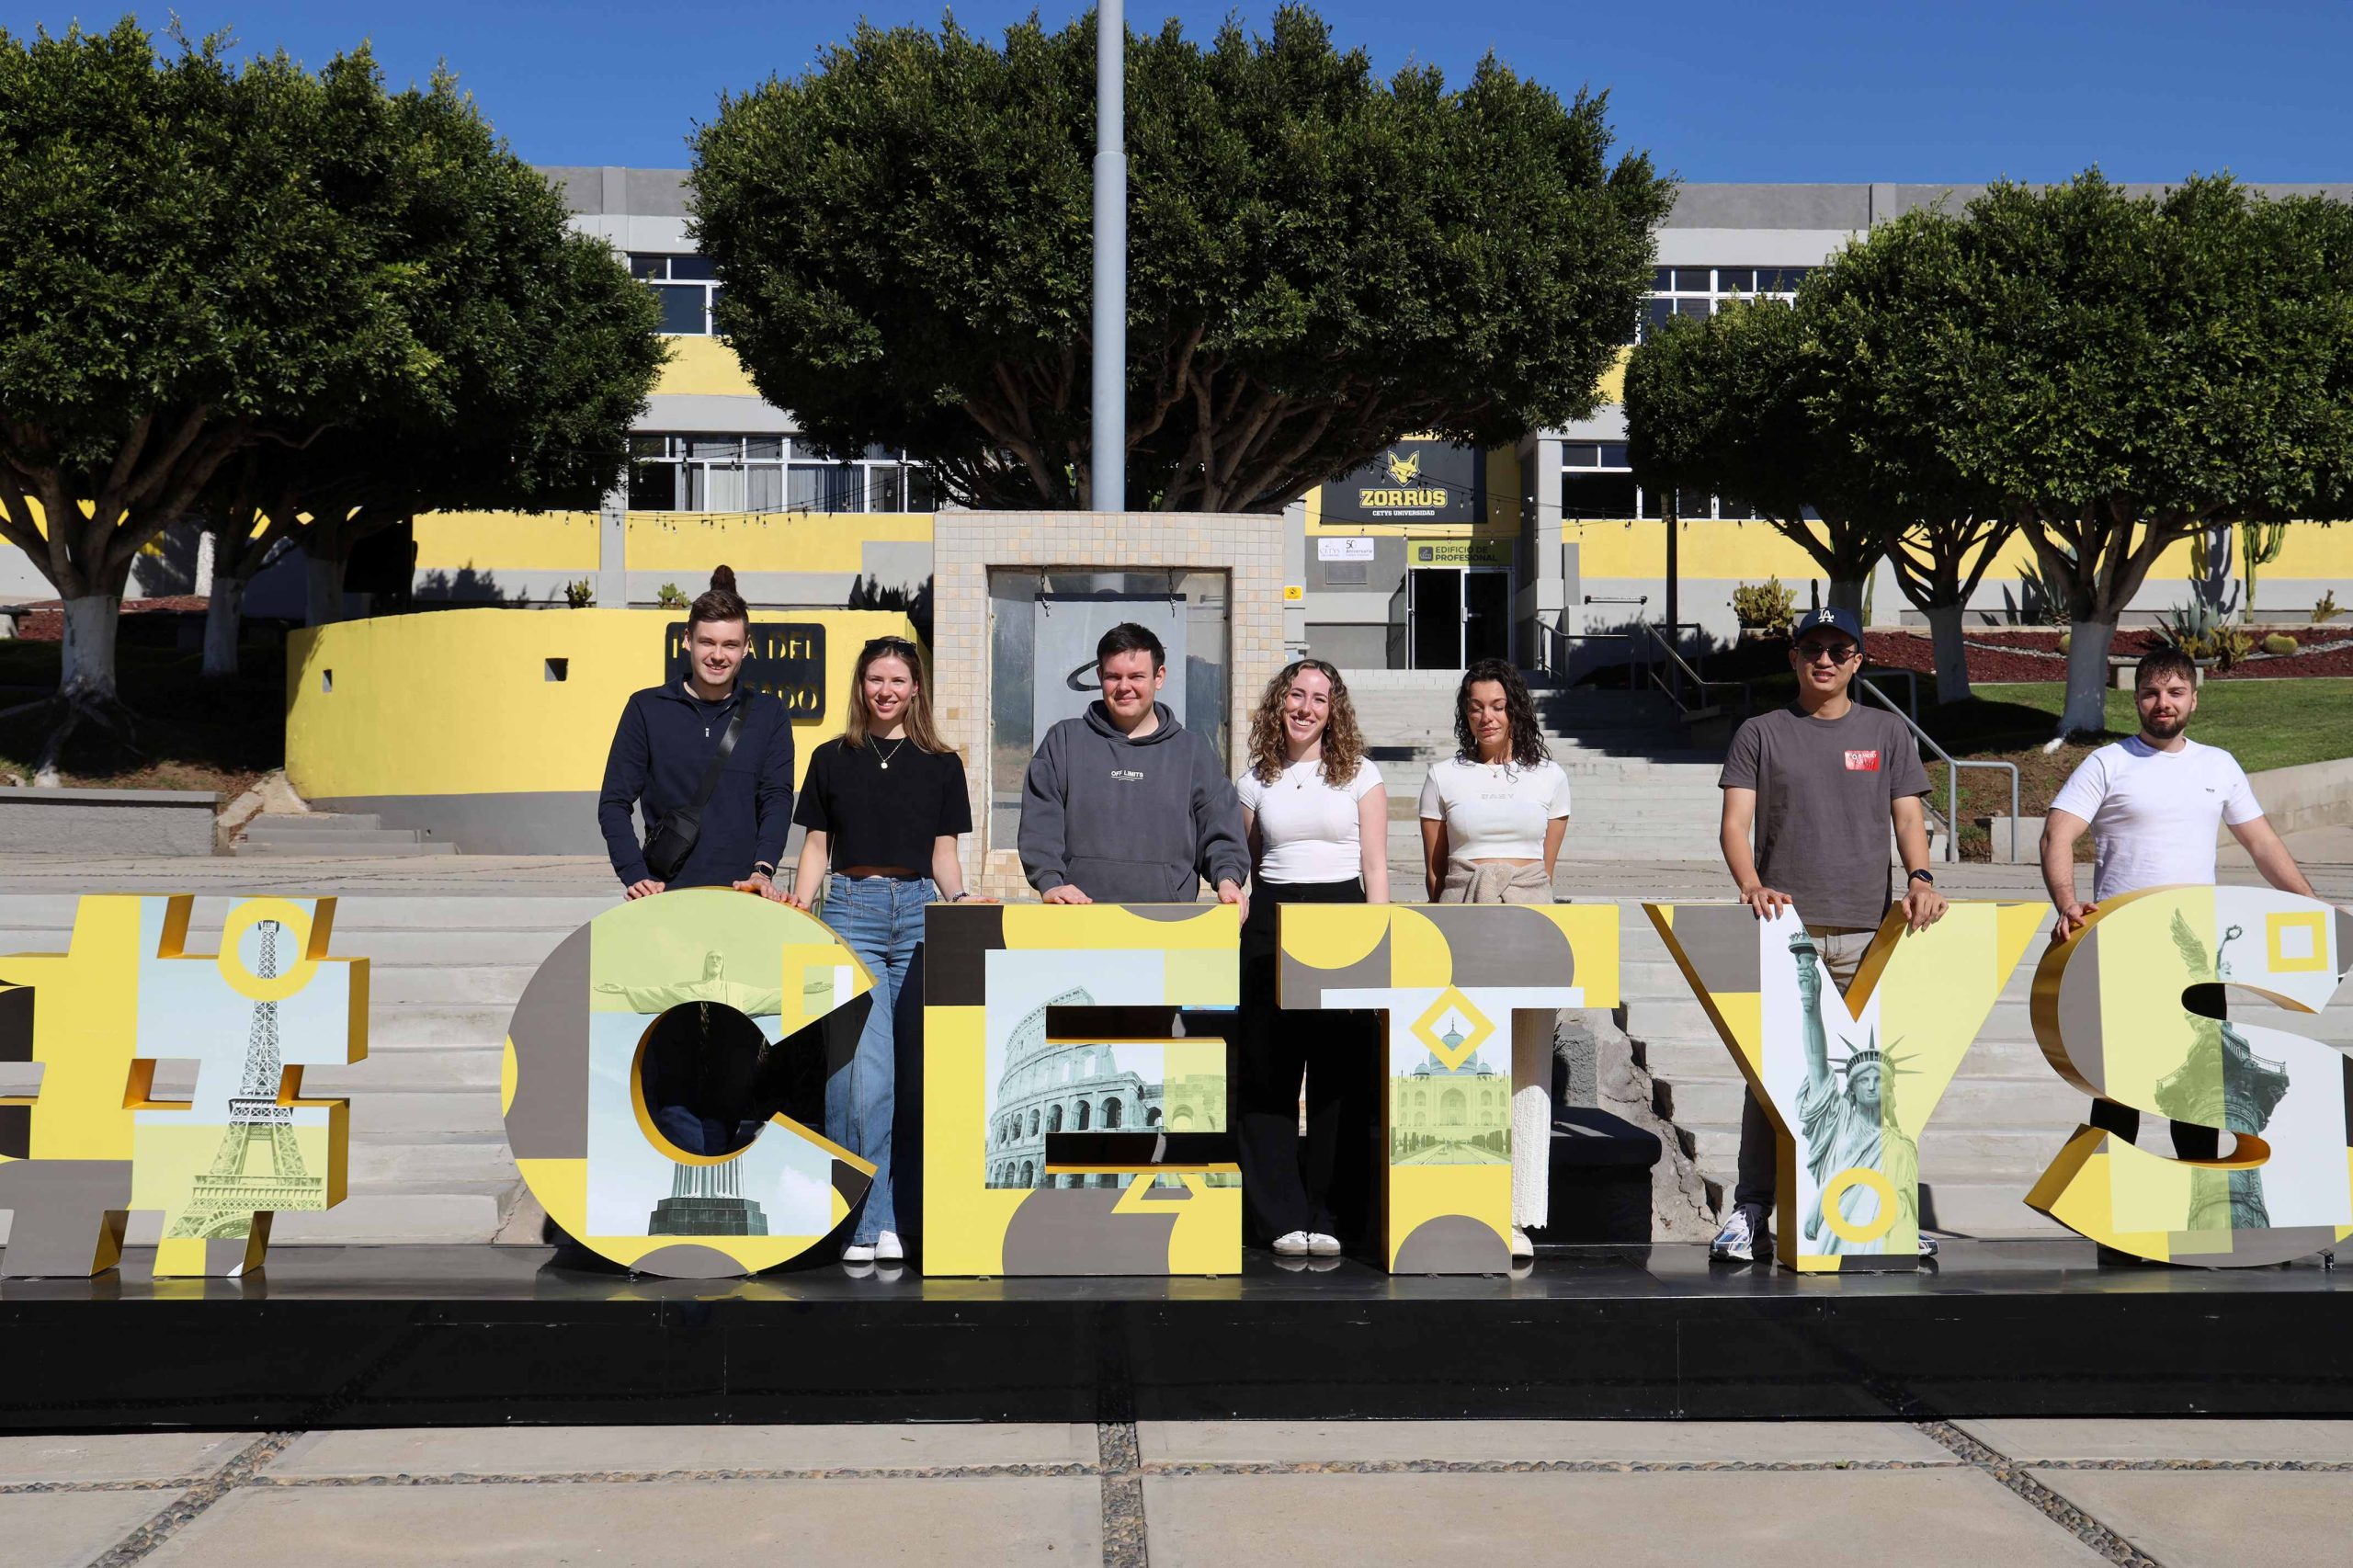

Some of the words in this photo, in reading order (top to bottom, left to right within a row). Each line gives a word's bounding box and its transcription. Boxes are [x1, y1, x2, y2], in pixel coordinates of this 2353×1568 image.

[1360, 489, 1448, 507] ZORROS
[1476, 546, 1488, 554] DE
[1818, 608, 1835, 623] LA
[768, 634, 815, 660] DEL
